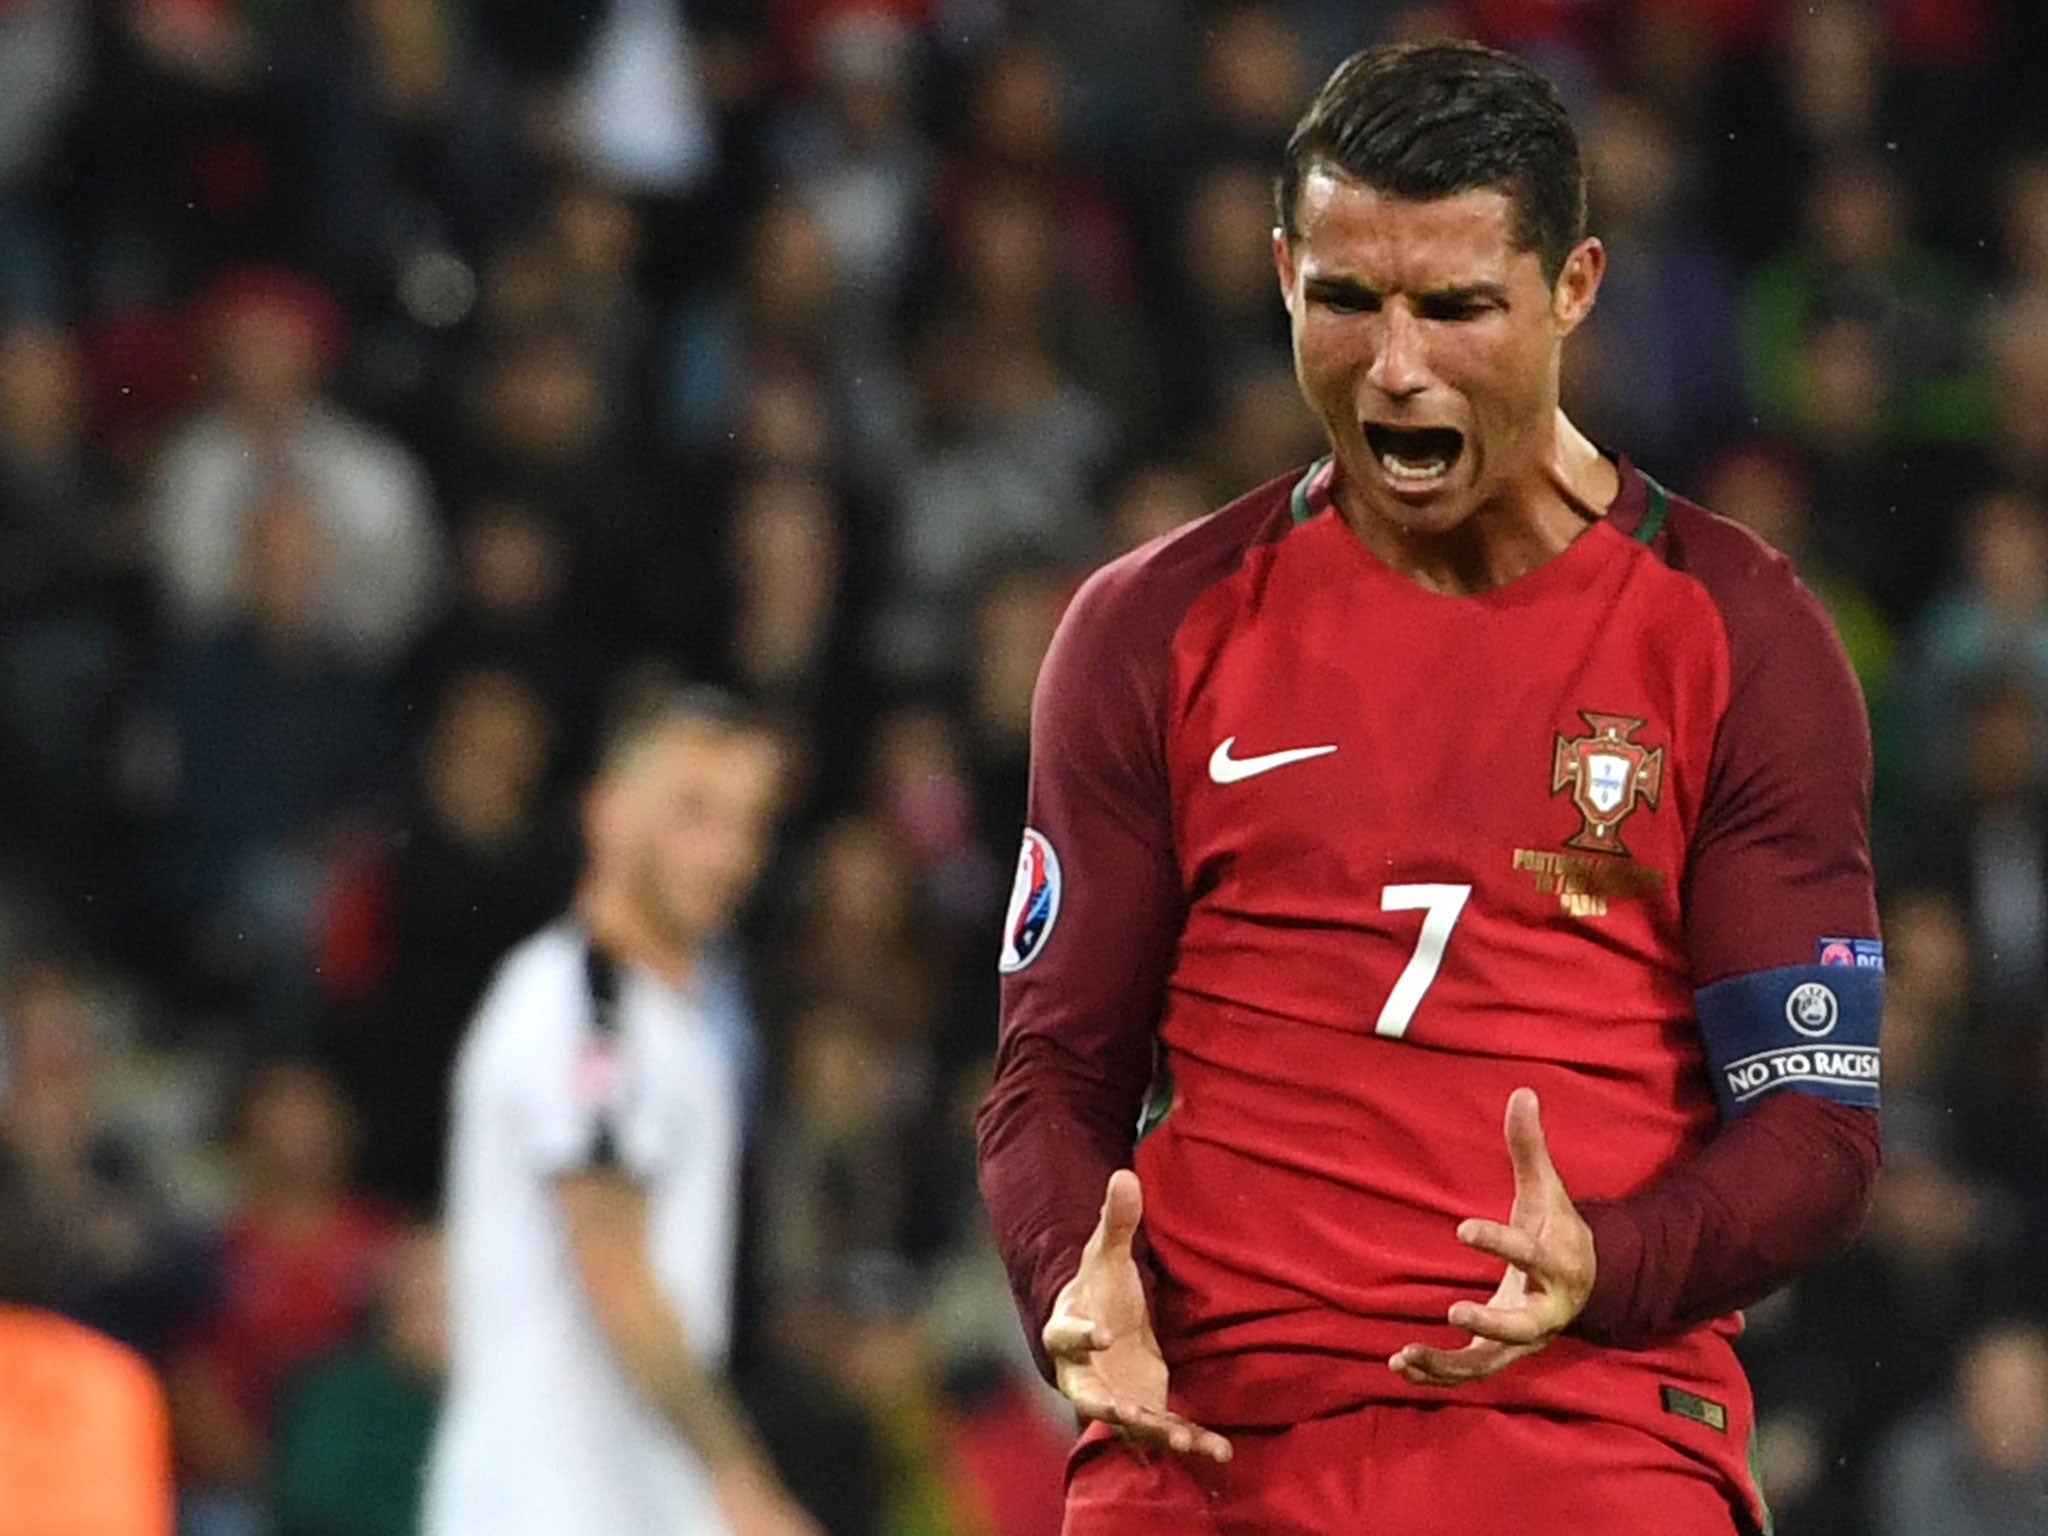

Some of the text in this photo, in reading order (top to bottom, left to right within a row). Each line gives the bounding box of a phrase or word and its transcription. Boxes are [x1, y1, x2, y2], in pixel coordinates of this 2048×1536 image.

[1374, 883, 1473, 1039] 7
[1727, 1062, 1769, 1094] NO
[1771, 1053, 1810, 1077] TO
